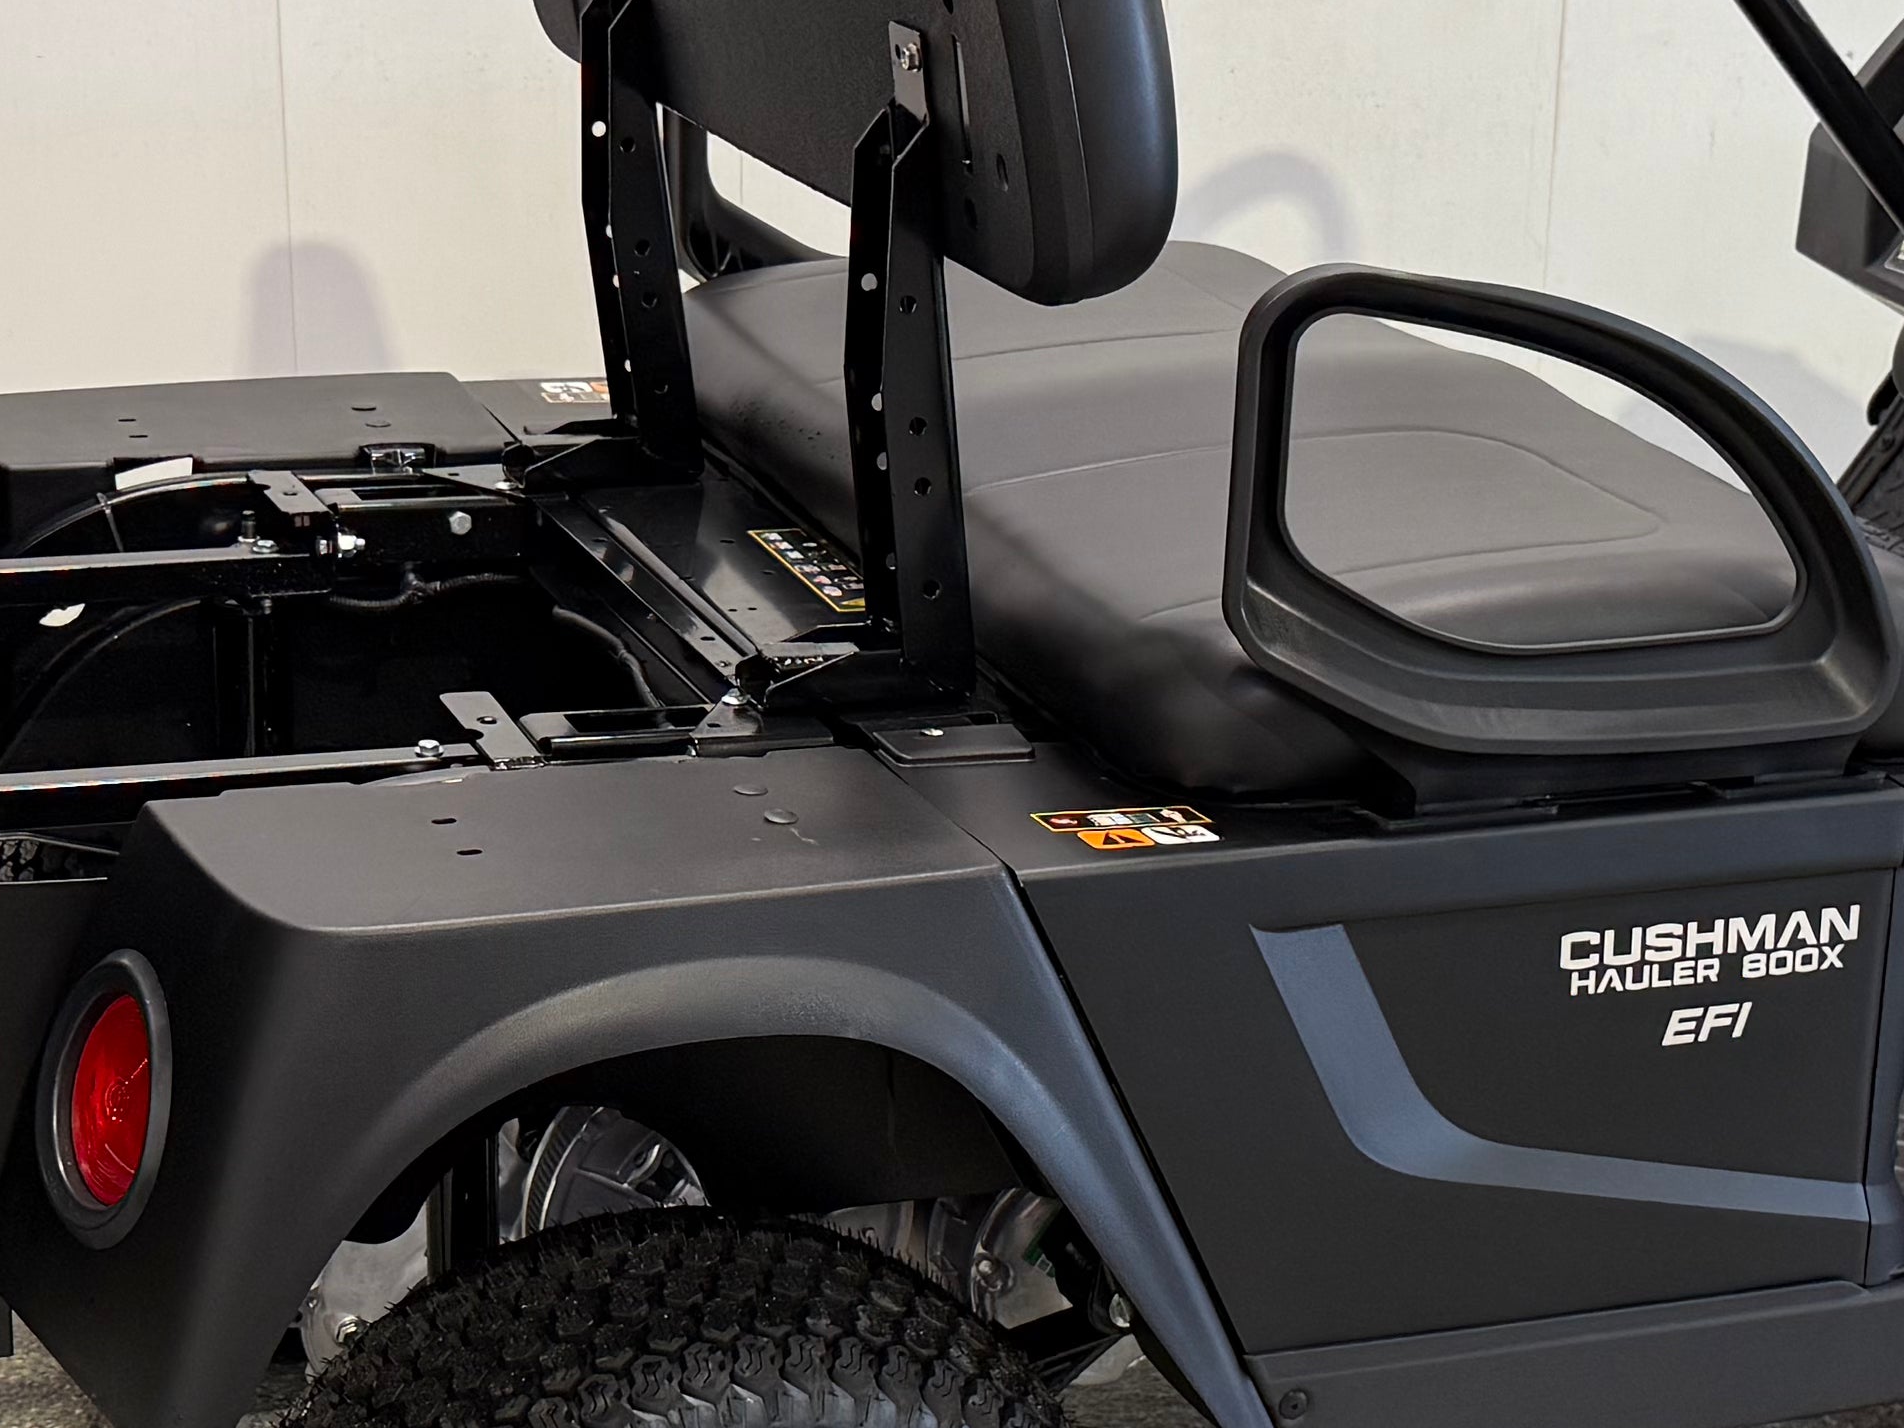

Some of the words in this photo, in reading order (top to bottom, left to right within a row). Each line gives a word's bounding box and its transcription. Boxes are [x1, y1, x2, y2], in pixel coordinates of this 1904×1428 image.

[1559, 904, 1861, 970] CUSHMAN
[1570, 957, 1720, 997] HAULER
[1741, 943, 1845, 979] 800X
[1661, 1001, 1753, 1047] EFI
